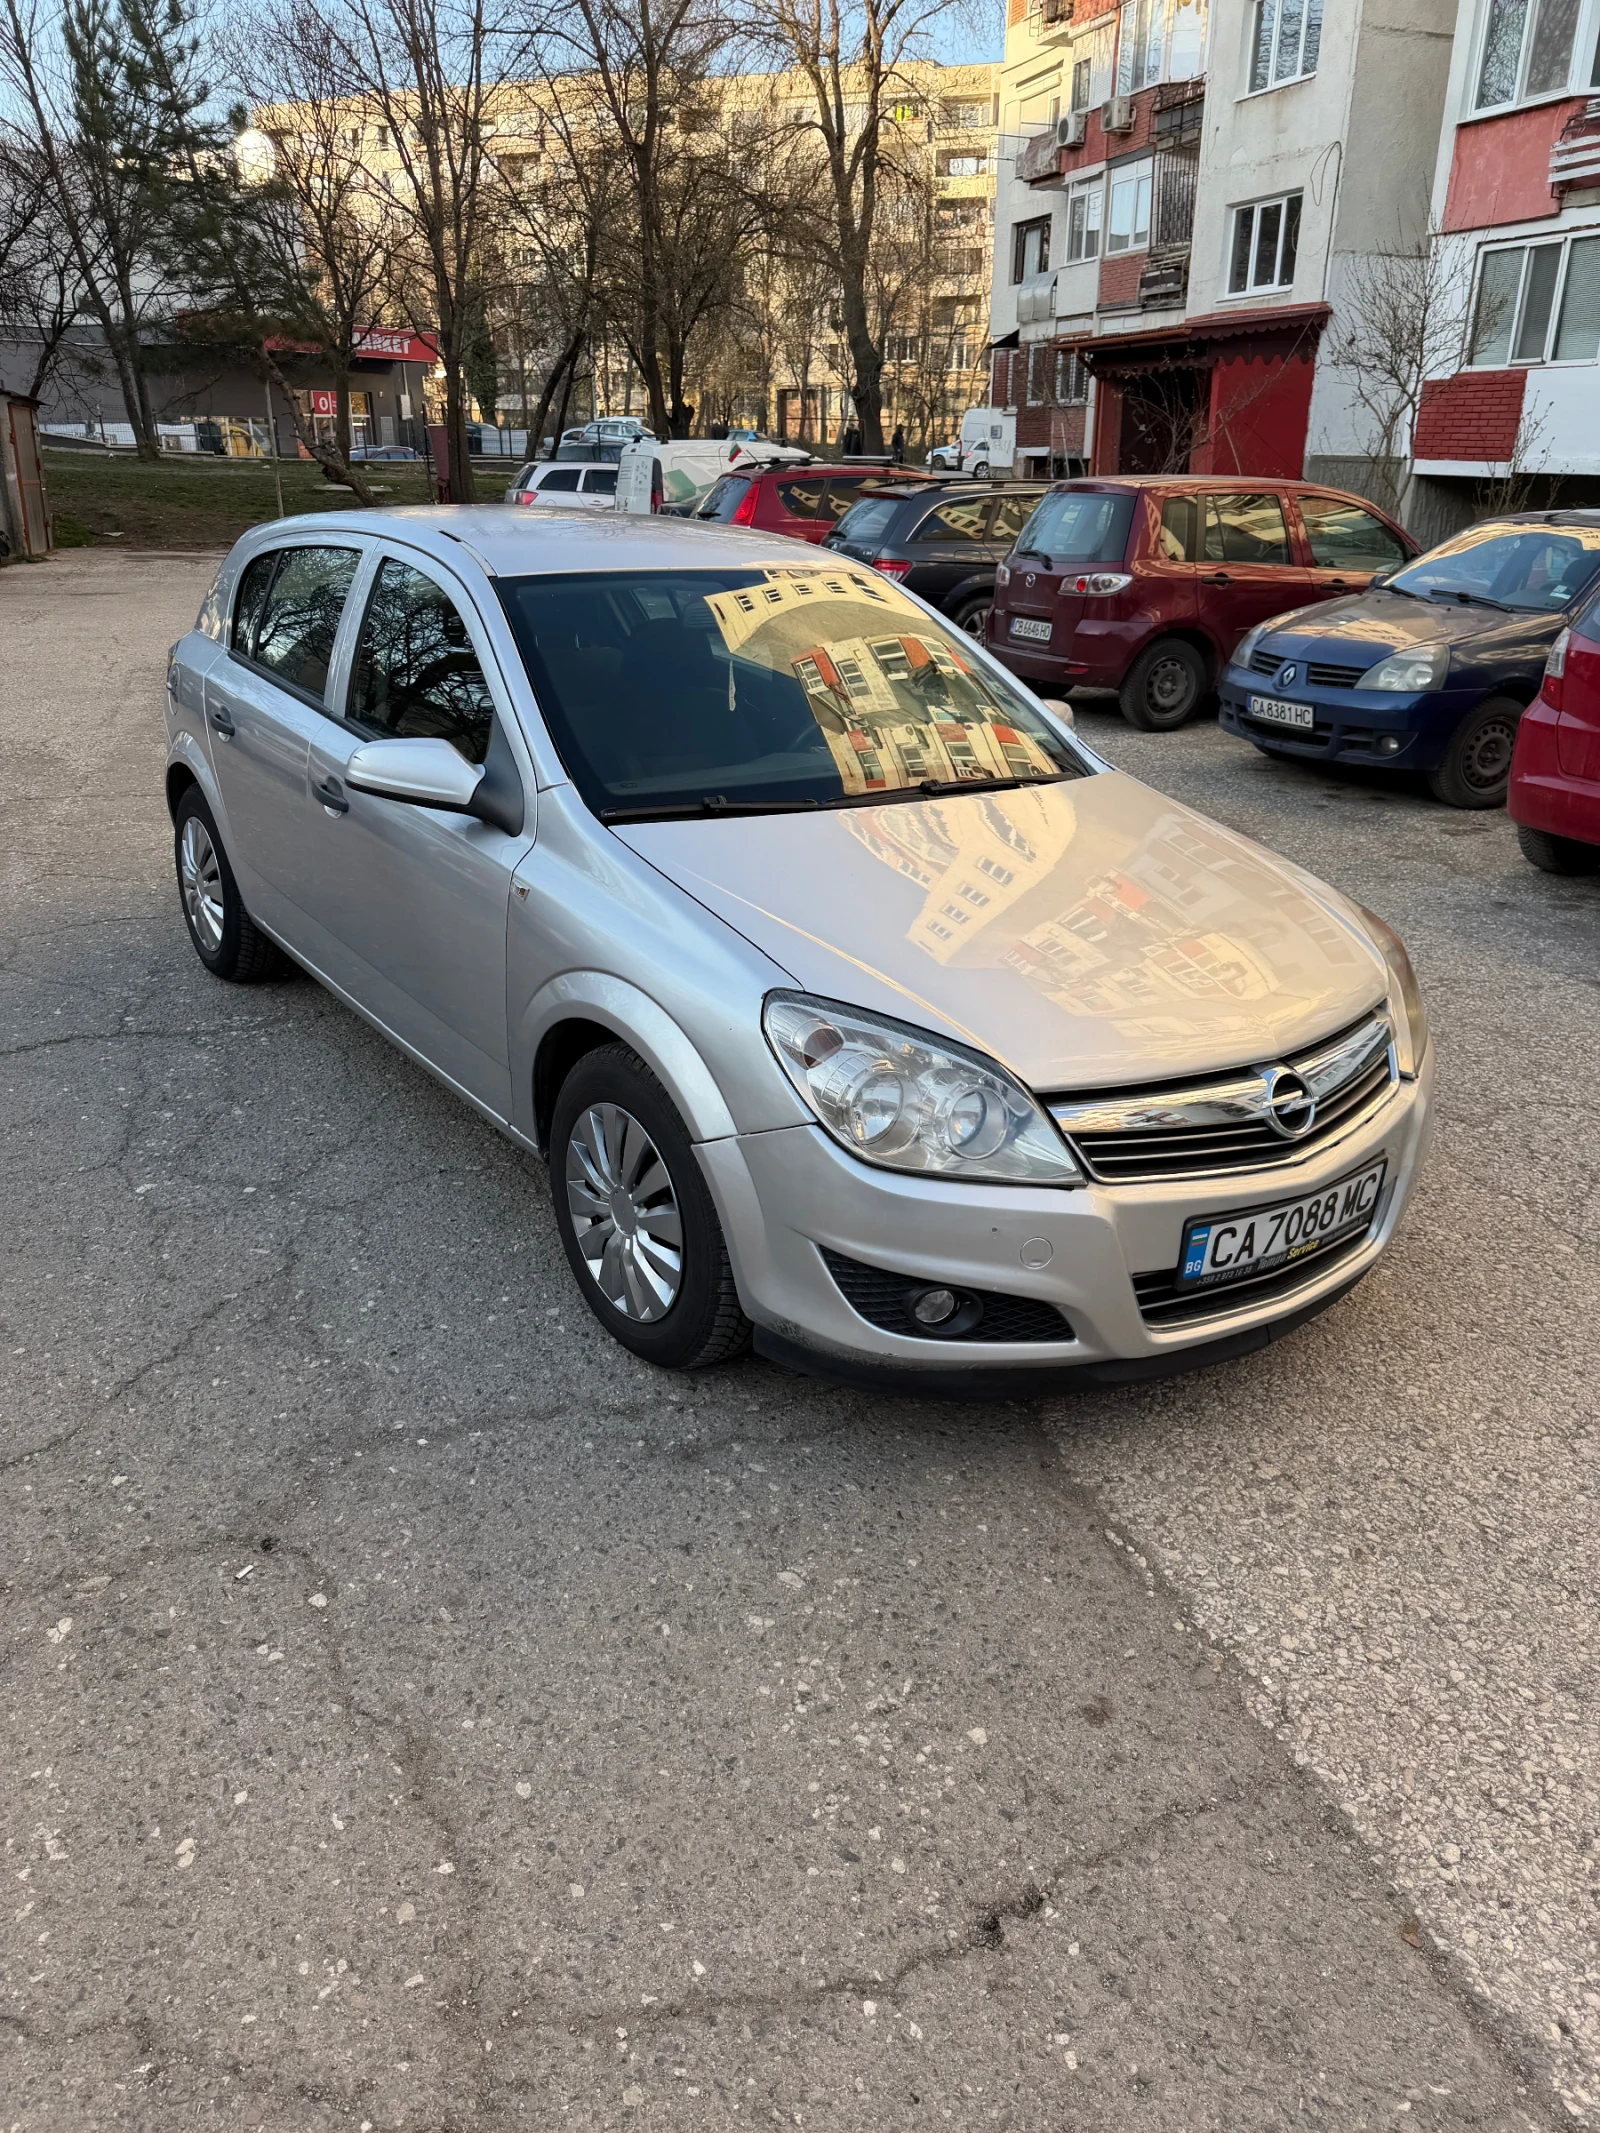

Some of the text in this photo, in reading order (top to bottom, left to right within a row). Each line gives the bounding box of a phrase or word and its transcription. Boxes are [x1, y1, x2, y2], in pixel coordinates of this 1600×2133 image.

[1252, 699, 1311, 725] CA 8381 HC
[1210, 1221, 1256, 1269] CA
[1262, 1191, 1339, 1255] 7088
[1338, 1172, 1378, 1224] MC
[1185, 1259, 1202, 1274] BG
[1257, 1239, 1320, 1270] Tempo Service
